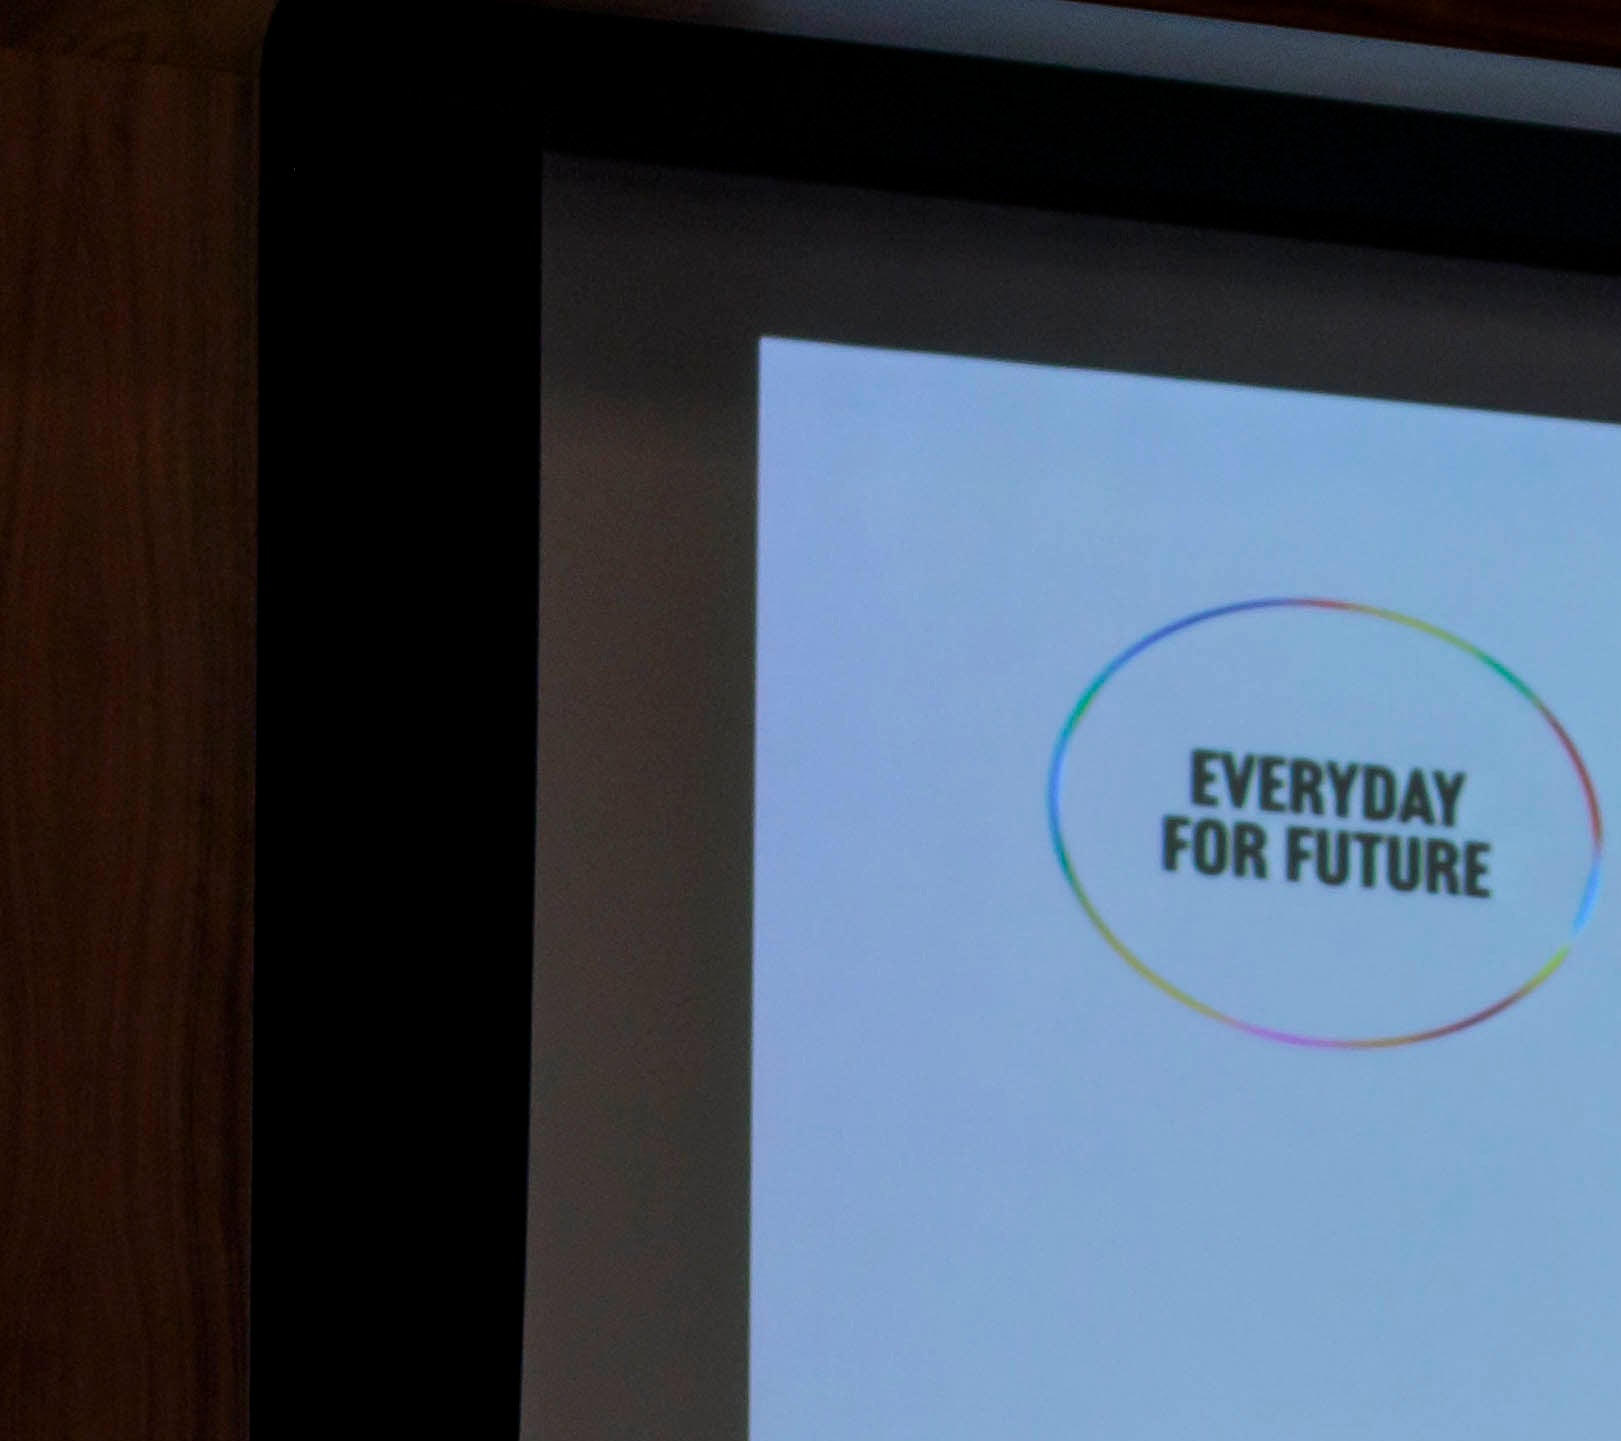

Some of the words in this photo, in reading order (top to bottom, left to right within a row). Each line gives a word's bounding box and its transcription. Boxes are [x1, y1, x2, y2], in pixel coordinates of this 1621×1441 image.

[1191, 748, 1467, 827] EVERYDAY
[1162, 815, 1268, 879] FOR
[1286, 826, 1491, 898] FUTURE
